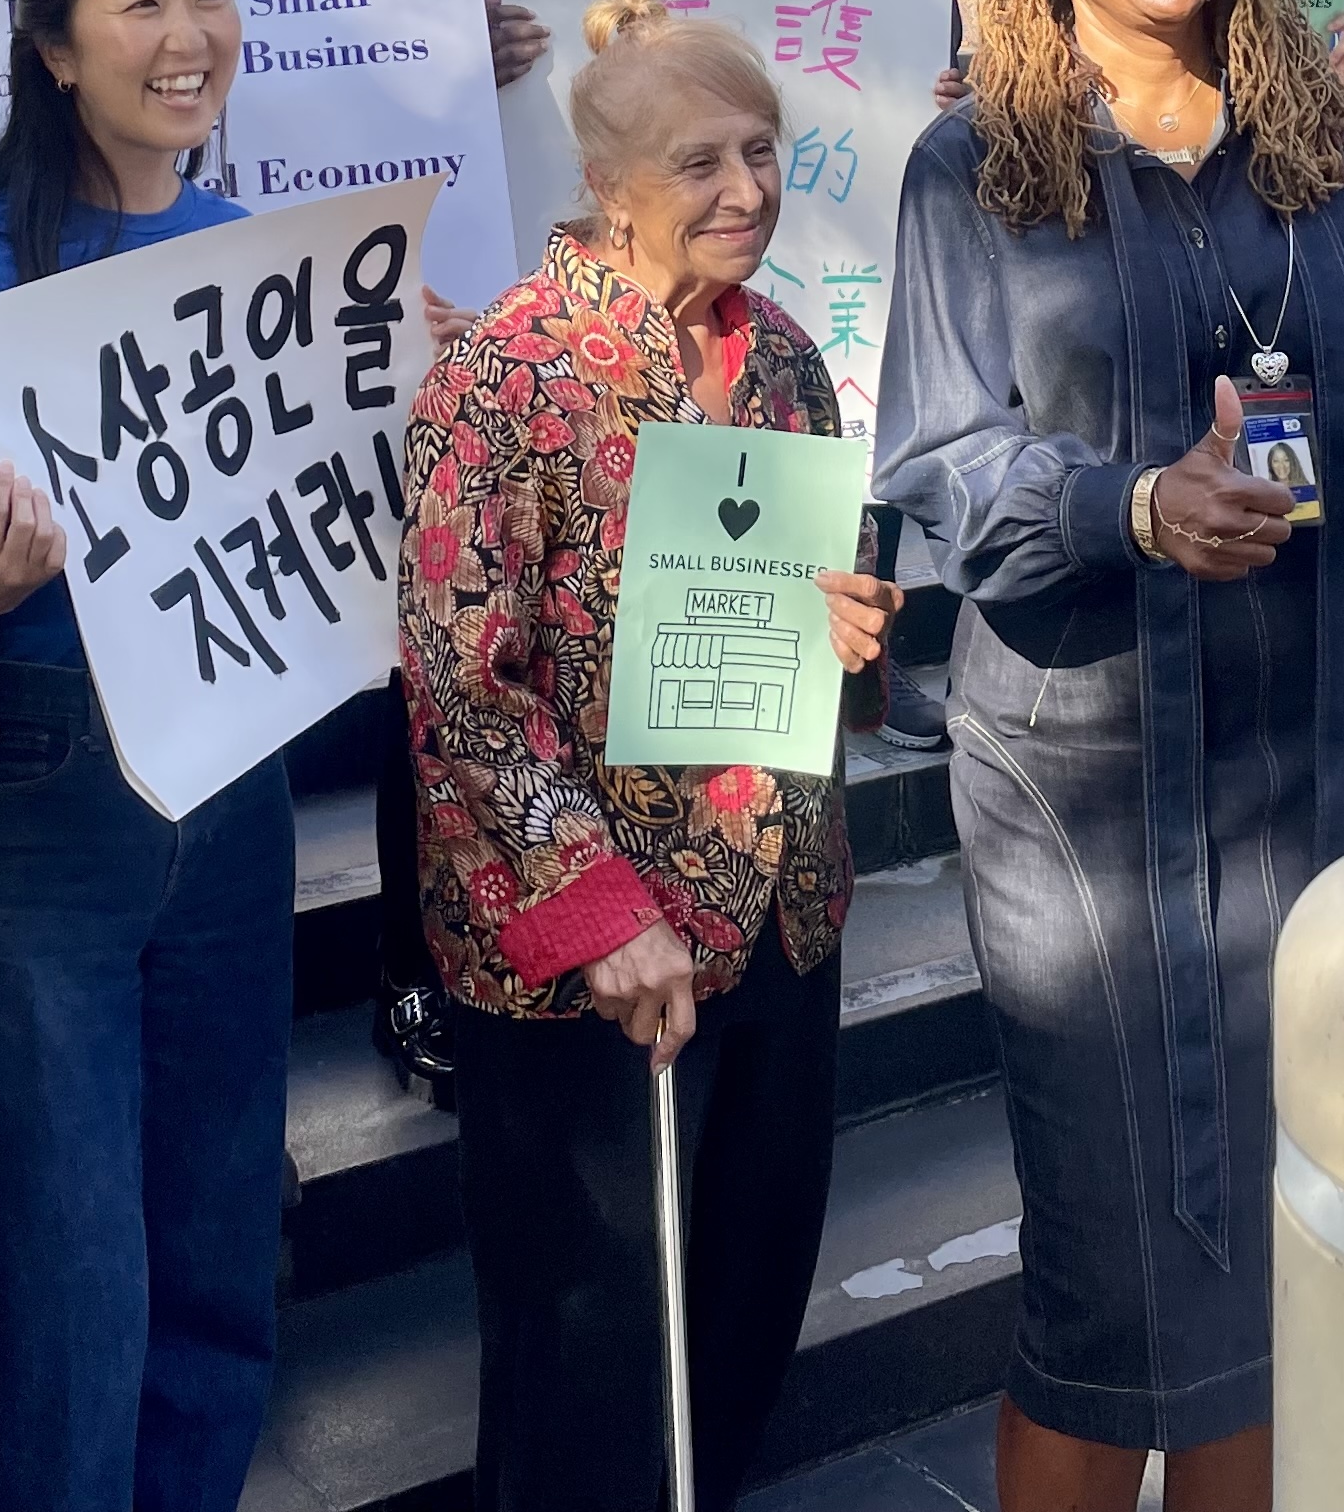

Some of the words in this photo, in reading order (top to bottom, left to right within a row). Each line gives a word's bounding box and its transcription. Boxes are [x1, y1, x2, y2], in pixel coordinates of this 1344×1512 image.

[242, 36, 429, 74] Business
[257, 154, 466, 196] Economy
[785, 126, 857, 204] 的
[23, 224, 407, 583] 소상공인을
[737, 452, 747, 487] I
[649, 553, 706, 571] SMALL
[690, 592, 767, 617] MARKET
